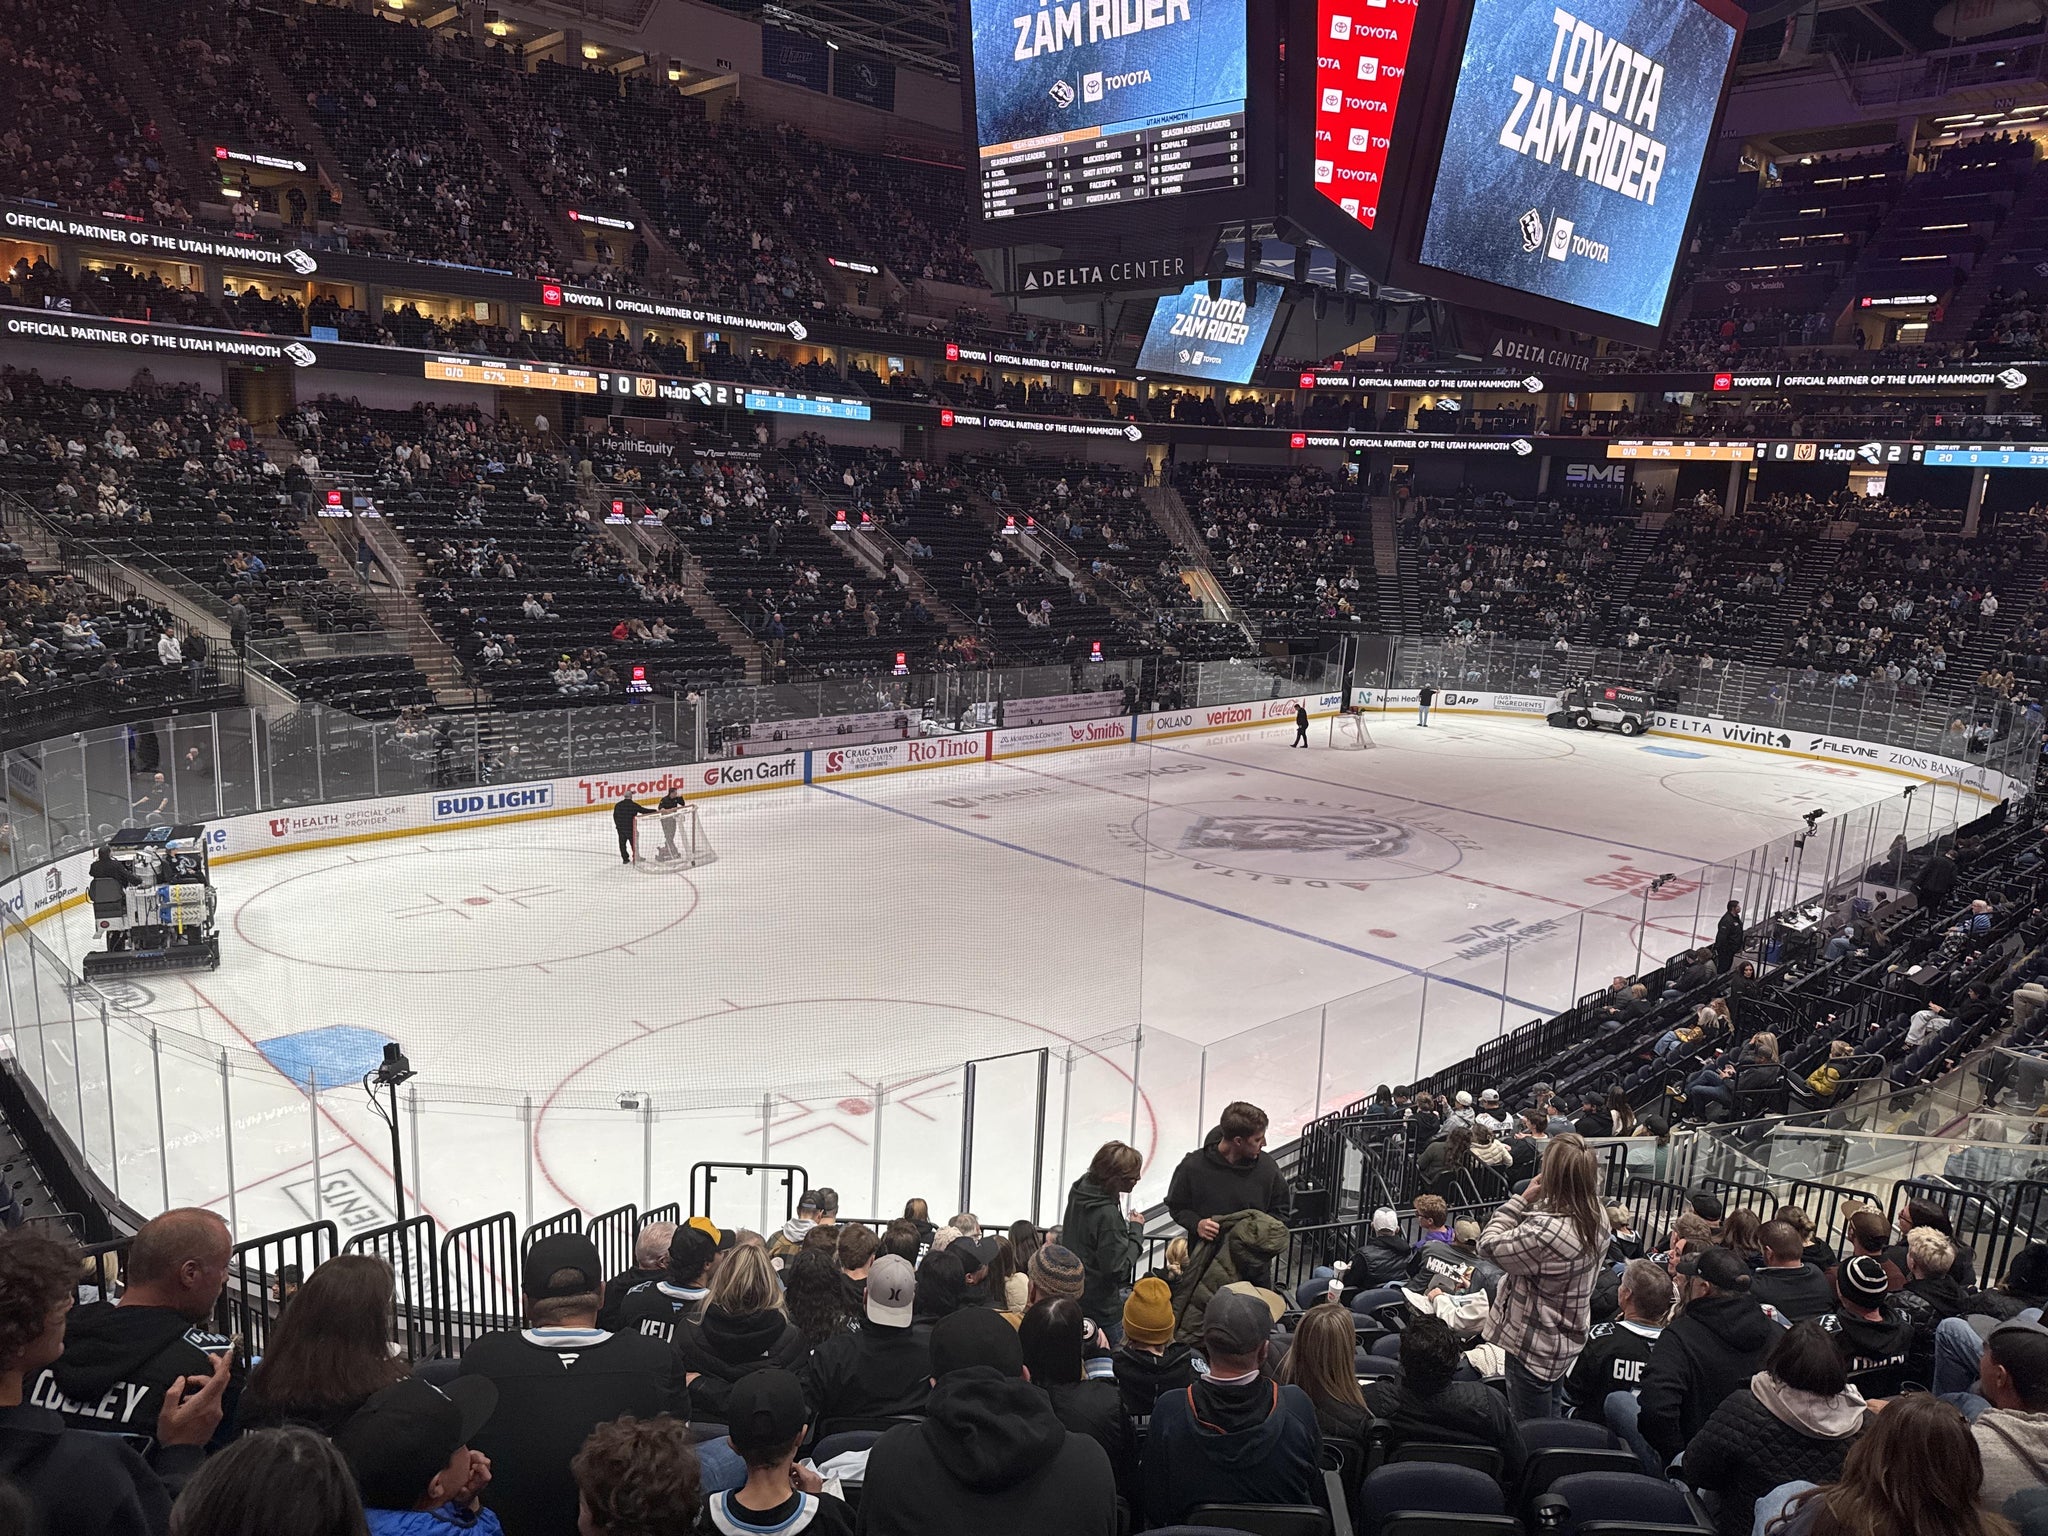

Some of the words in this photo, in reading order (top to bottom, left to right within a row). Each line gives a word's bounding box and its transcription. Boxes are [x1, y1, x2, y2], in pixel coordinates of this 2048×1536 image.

[1013, 1, 1082, 61] ZAM
[1355, 25, 1398, 40] TOYOTA
[1547, 7, 1664, 130] TOYOTA
[1105, 70, 1152, 90] TOYOTA
[1345, 98, 1388, 112] TOYOTA
[1147, 117, 1160, 126] UTAH
[1161, 127, 1184, 138] SEASON
[1204, 119, 1231, 131] LEADERS
[1500, 75, 1583, 171] ZAM
[1577, 112, 1667, 206] RIDER
[1337, 169, 1378, 182] TOYOTA
[5, 212, 67, 234] OFFICIAL
[69, 222, 126, 243] PARTNER
[129, 232, 149, 246] OF
[151, 235, 176, 250] THE
[178, 239, 213, 254] UTAH
[215, 245, 282, 264] MAMMOTH
[1572, 234, 1609, 263] TOYOTA
[1043, 267, 1102, 287] DELTA
[1110, 258, 1185, 281] CENTER
[563, 292, 603, 307] TOYOTA
[616, 300, 654, 314] OFFICIAL
[655, 305, 692, 319] PARTNER
[693, 311, 705, 321] OF
[706, 312, 722, 324] THE
[723, 315, 744, 327] UTAH
[745, 319, 786, 333] MAMMOTH
[1191, 293, 1247, 323] TOYOTA
[8, 319, 68, 338] OFFICIAL
[71, 326, 127, 345] PARTNER
[130, 332, 149, 347] OF
[152, 335, 176, 349] THE
[179, 337, 213, 351] UTAH
[216, 342, 281, 359] MAMMOTH
[1170, 314, 1208, 338] ZAM
[1204, 320, 1249, 345] RIDER
[959, 349, 986, 361] TOYOTA
[994, 354, 1021, 365] OFFICIAL
[1022, 358, 1050, 368] PARTNER
[1050, 361, 1061, 369] OF
[1062, 362, 1074, 370] THE
[1074, 363, 1092, 372] UTAH
[1203, 355, 1222, 364] TOYOTA
[1506, 341, 1545, 363] DELTA
[1548, 350, 1590, 372] CENTER
[445, 367, 464, 378] 0/0
[483, 371, 506, 382] 67%
[1316, 377, 1349, 386] TOYOTA
[1359, 378, 1392, 387] OFFICIAL
[1394, 378, 1427, 387] PARTNER
[1428, 379, 1440, 387] OF
[1441, 379, 1455, 388] THE
[1457, 379, 1477, 388] UTAH
[1479, 380, 1520, 389] MAMMOTH
[1733, 377, 1772, 387] TOYOTA
[1784, 376, 1825, 387] OFFICIAL
[1827, 375, 1869, 385] PARTNER
[1870, 374, 1885, 385] OF
[1887, 374, 1906, 385] THE
[1908, 374, 1935, 384] UTAH
[1937, 373, 1995, 384] MAMMOTH
[618, 377, 630, 393] 0
[659, 385, 691, 400] 14:00
[717, 387, 727, 403] 2
[755, 399, 766, 407] 20
[817, 405, 832, 414] 33%
[954, 416, 981, 426] TOYOTA
[989, 418, 1015, 429] OFFICIAL
[1016, 421, 1044, 431] PARTNER
[1044, 423, 1055, 432] OF
[1055, 424, 1067, 433] THE
[1068, 424, 1086, 434] UTAH
[1086, 426, 1122, 436] MAMMOTH
[602, 438, 673, 457] HealthEquity
[1307, 437, 1340, 446] TOYOTA
[1349, 438, 1383, 448] OFFICIAL
[1384, 439, 1417, 448] PARTNER
[1418, 440, 1430, 449] OF
[1430, 440, 1445, 449] THE
[1446, 440, 1466, 450] UTAH
[1468, 441, 1509, 450] MAMMOTH
[1623, 448, 1637, 456] 0/0
[1776, 444, 1788, 459] 0
[1819, 448, 1855, 461] 14:00
[1887, 446, 1901, 461] 2
[1939, 454, 1953, 462] 20
[1566, 463, 1626, 483] SME
[1458, 696, 1479, 705] App
[1497, 700, 1543, 709] INGREDIENTS
[1618, 693, 1642, 703] TOYOTA
[1157, 715, 1192, 729] OKLAND
[1207, 707, 1251, 725] verizon
[1656, 716, 1712, 734] DELTA
[1086, 722, 1124, 740] Smith's
[1723, 725, 1774, 746] vivint
[845, 748, 870, 758] CRAIG
[872, 746, 897, 756] SWAPP
[856, 754, 893, 764] ASSOCIATES
[908, 742, 937, 761] Rio
[937, 739, 978, 757] Tinto
[1823, 741, 1879, 758] FILEVINE
[721, 765, 753, 783] Ken
[756, 758, 796, 779] Garff
[1890, 753, 1928, 770] ZIONS
[1931, 761, 1962, 777] BANK
[595, 774, 684, 798] Trucordia
[437, 795, 484, 815] BUD
[487, 788, 549, 811] LIGHT
[1264, 795, 1377, 814] DELTA
[293, 815, 338, 828] HEALTH
[345, 809, 382, 820] OFFICIAL
[385, 806, 405, 815] CARE
[345, 817, 387, 827] PROVIDER
[1395, 816, 1483, 851] CENTER
[1193, 862, 1330, 889] DELTA
[1584, 866, 1655, 890] SEAT
[190, 1331, 230, 1344] UTAH
